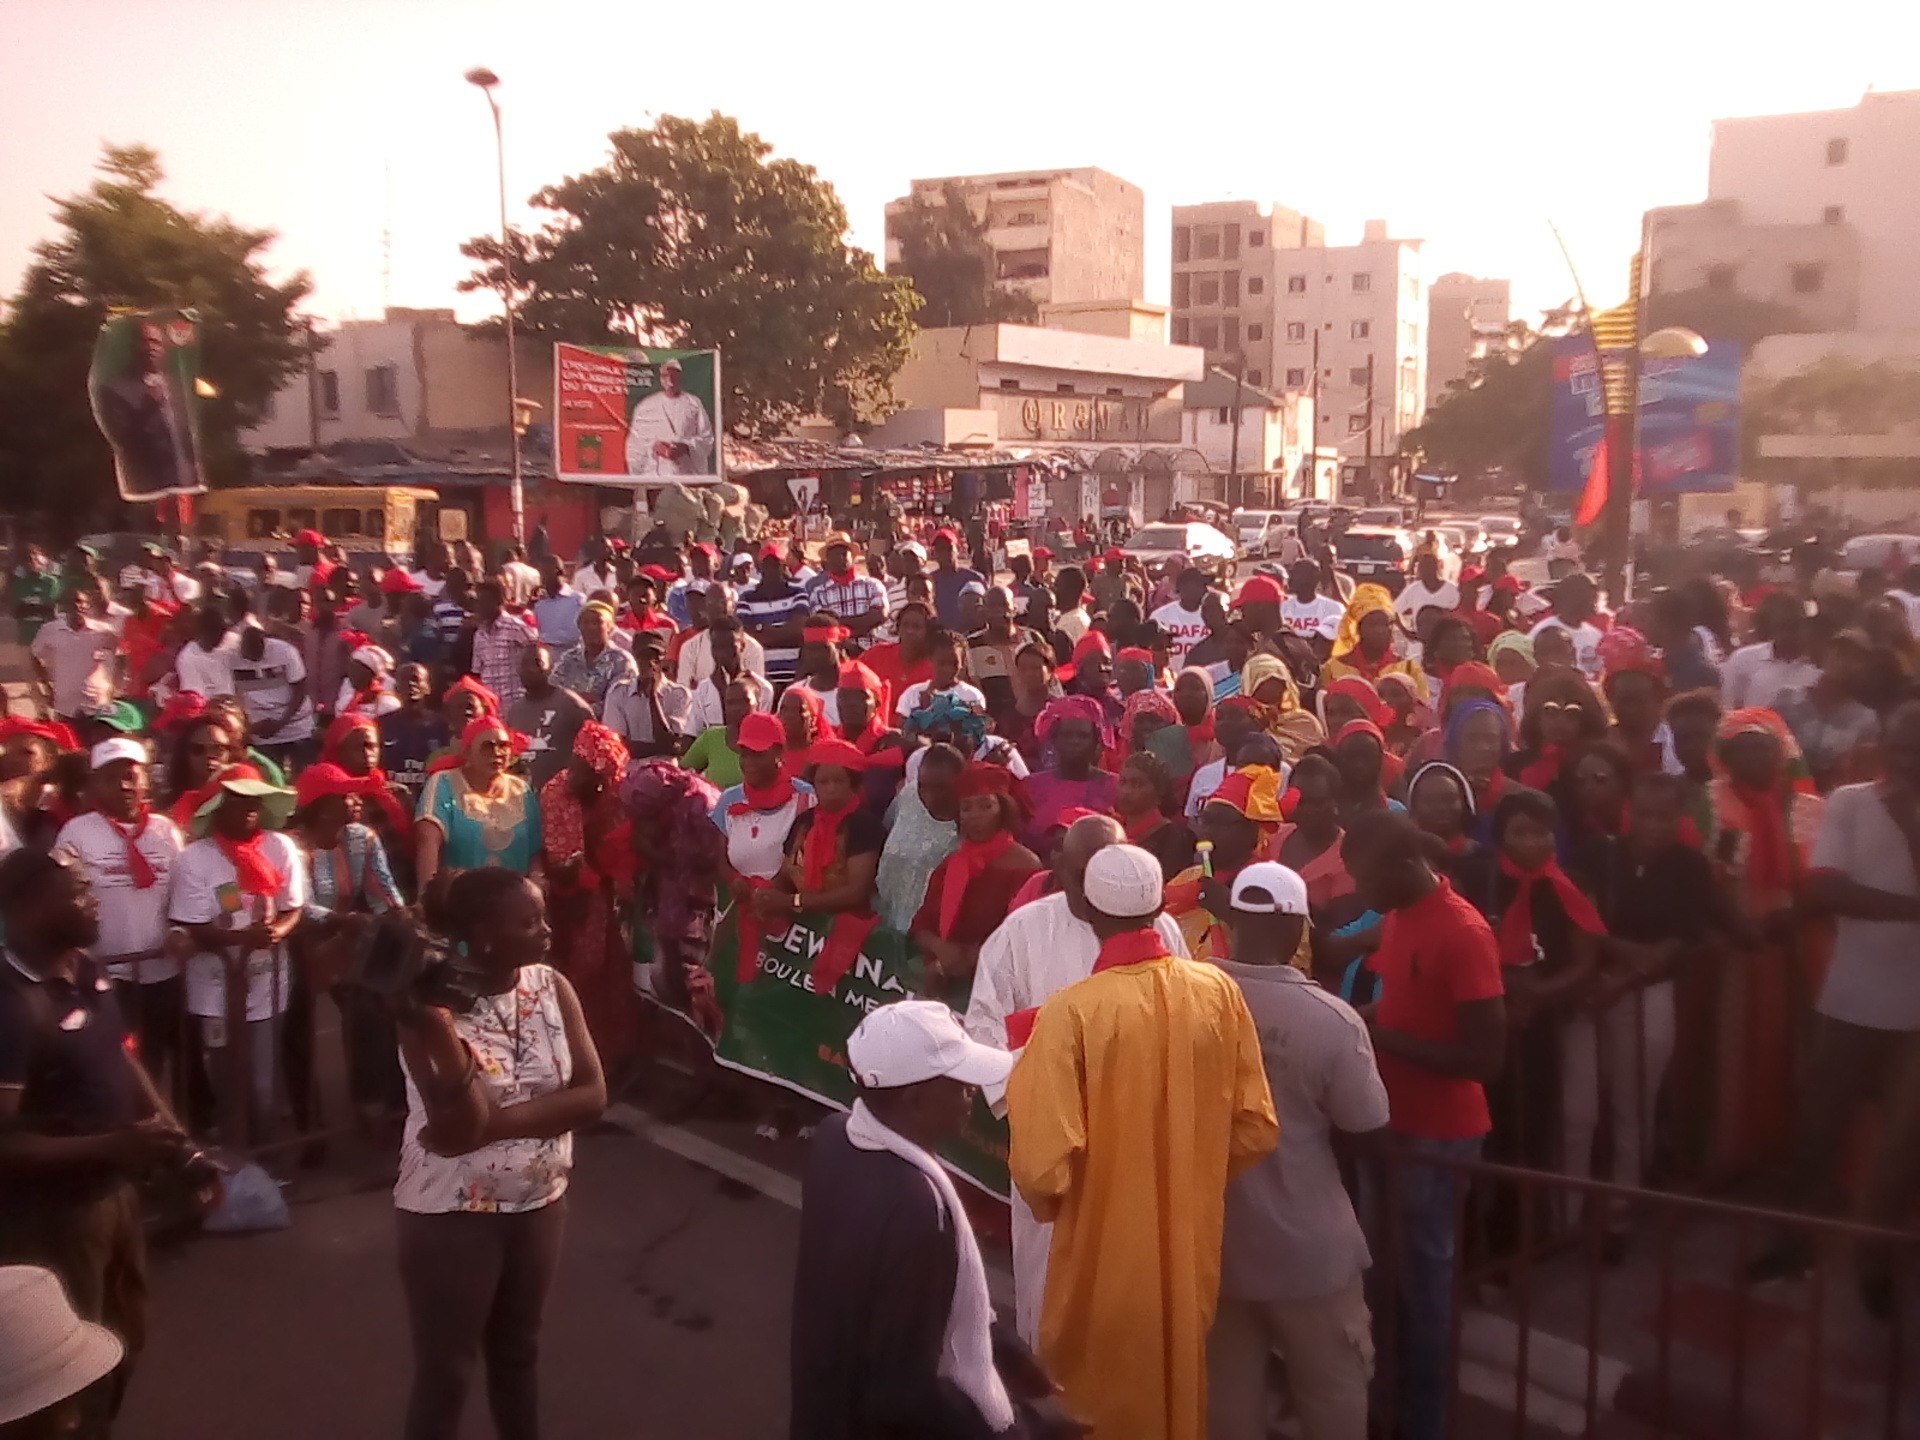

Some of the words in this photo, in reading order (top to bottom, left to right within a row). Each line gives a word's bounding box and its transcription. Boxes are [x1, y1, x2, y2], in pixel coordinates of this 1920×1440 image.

[1169, 624, 1210, 637] DAFA
[387, 770, 426, 783] Emira
[845, 989, 880, 1014] ME
